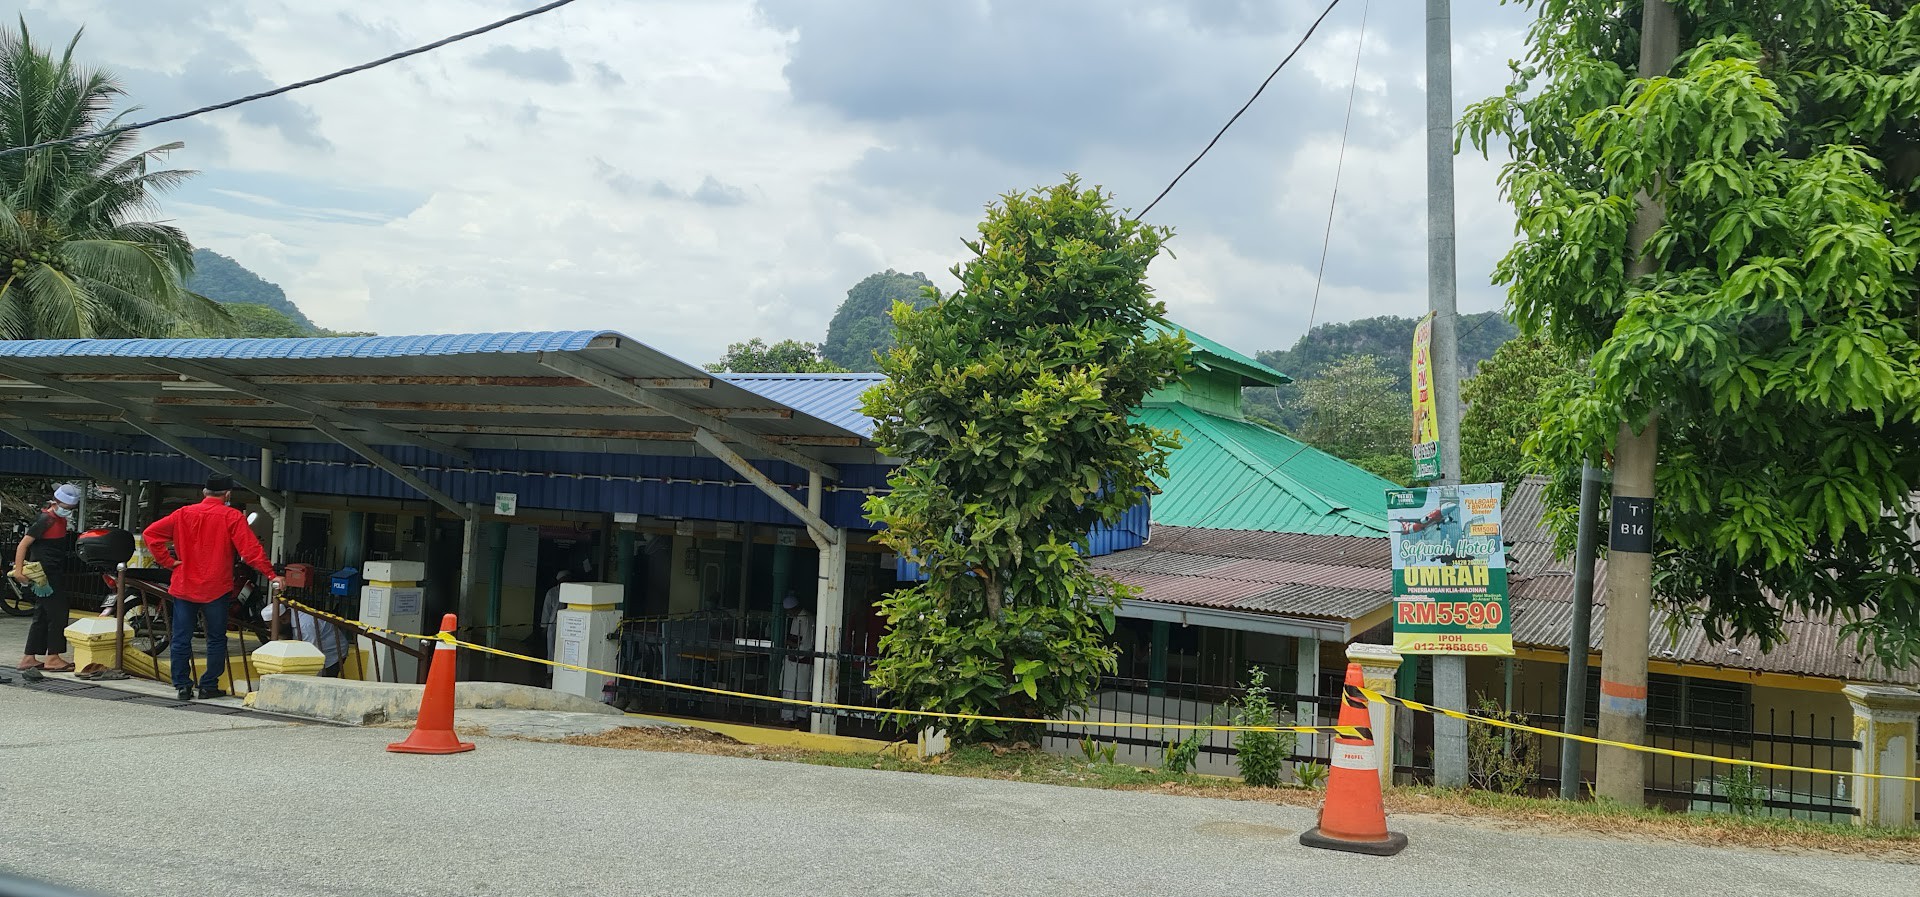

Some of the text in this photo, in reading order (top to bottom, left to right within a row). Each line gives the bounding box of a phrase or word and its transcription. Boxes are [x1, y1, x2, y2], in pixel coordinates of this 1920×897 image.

[1400, 538, 1496, 561] Safwah Hotel
[1404, 566, 1490, 586] UMRAH
[1398, 602, 1502, 625] RM5590
[1414, 643, 1488, 652] 012-7858656
